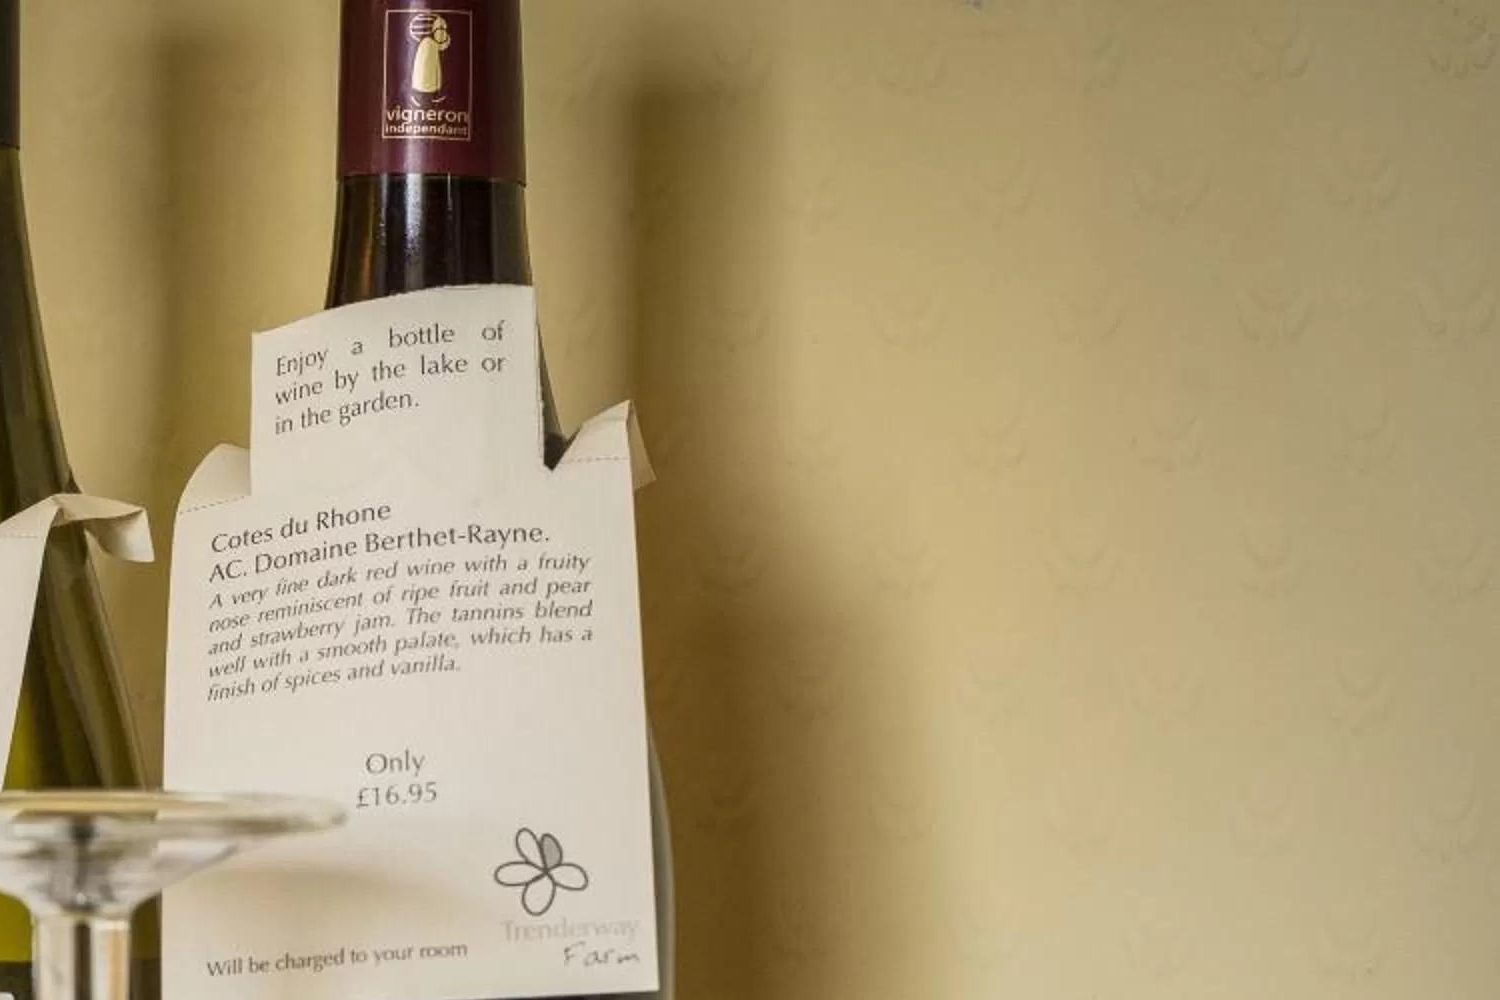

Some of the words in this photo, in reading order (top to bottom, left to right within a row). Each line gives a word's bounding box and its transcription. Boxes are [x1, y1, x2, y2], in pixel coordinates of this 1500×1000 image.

[387, 106, 469, 123] vigneron
[276, 347, 329, 378] Enjoy
[351, 339, 364, 356] a
[388, 323, 456, 350] bottle
[481, 319, 507, 342] of
[274, 378, 323, 406] wine
[334, 367, 359, 391] by
[372, 360, 406, 381] the
[420, 353, 469, 377] lake
[481, 353, 507, 373] or
[274, 414, 294, 434] in
[301, 406, 332, 429] the
[339, 390, 420, 424] garden.
[211, 526, 274, 553] Cotes
[280, 518, 308, 541] du
[315, 502, 392, 531] Rhone
[208, 559, 247, 585] AC.
[255, 539, 358, 575] Domaine
[365, 522, 551, 553] Berthet-Rayne.
[208, 593, 224, 609] A
[231, 587, 269, 607] very
[274, 577, 309, 598] fine
[317, 569, 357, 589] dark
[365, 563, 398, 581] red
[407, 558, 456, 576] wine
[464, 553, 508, 572] with
[516, 557, 528, 571] a
[537, 553, 592, 575] fruity
[208, 612, 249, 632] nose
[256, 592, 364, 626] reminiscent
[372, 587, 394, 606] of
[401, 583, 440, 606] ripe
[448, 579, 490, 600] fruit
[498, 578, 537, 596] and
[546, 579, 592, 600] pear
[207, 635, 243, 657] and
[250, 619, 346, 649] strawberry
[353, 612, 396, 635] jam.
[406, 606, 442, 626] The
[452, 600, 524, 621] tannins
[535, 600, 593, 619] blend
[207, 657, 246, 678] well
[253, 648, 292, 670] with
[299, 649, 309, 663] a
[317, 637, 387, 661] smooth
[394, 630, 461, 653] palate,
[471, 626, 531, 647] which
[540, 624, 573, 642] has
[581, 628, 593, 642] a
[207, 679, 256, 702] finish
[261, 671, 282, 693] of
[284, 666, 342, 692] spices
[347, 660, 383, 680] and
[390, 653, 462, 675] vanilla.
[365, 749, 426, 776] Only
[356, 782, 438, 809] £16.95
[503, 917, 641, 944] Trenderway
[562, 939, 640, 967] Farm
[207, 959, 243, 977] Will
[248, 956, 270, 974] be
[275, 949, 346, 973] charged
[350, 949, 368, 965] to
[373, 945, 415, 964] your
[419, 941, 467, 958] room
